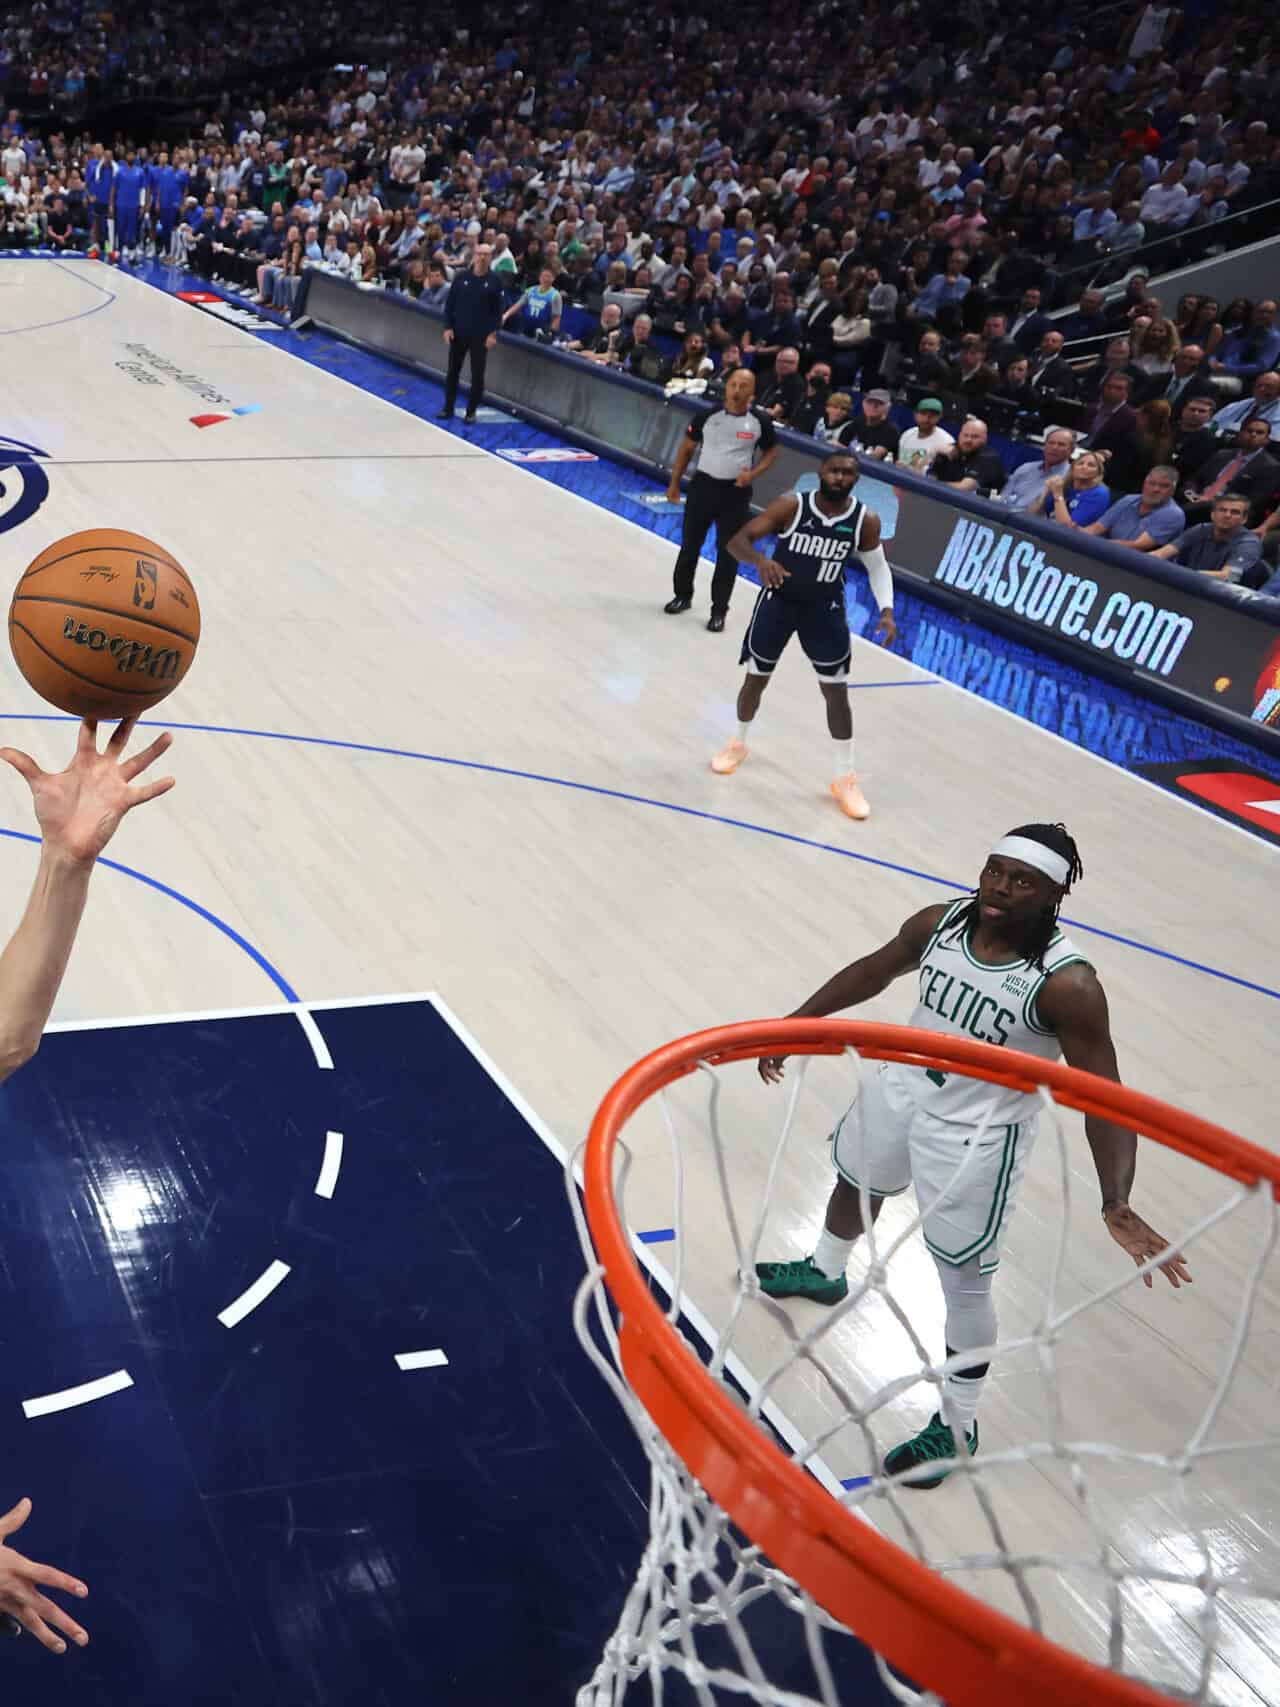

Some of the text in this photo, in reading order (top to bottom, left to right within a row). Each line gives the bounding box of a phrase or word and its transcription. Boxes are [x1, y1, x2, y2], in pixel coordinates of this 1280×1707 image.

[788, 531, 851, 561] MAVS
[816, 560, 842, 583] 10
[935, 517, 1194, 677] NBAStore.com
[1000, 983, 1028, 999] PRINT
[1005, 973, 1031, 992] VISTA
[919, 963, 1017, 1047] CELTICS
